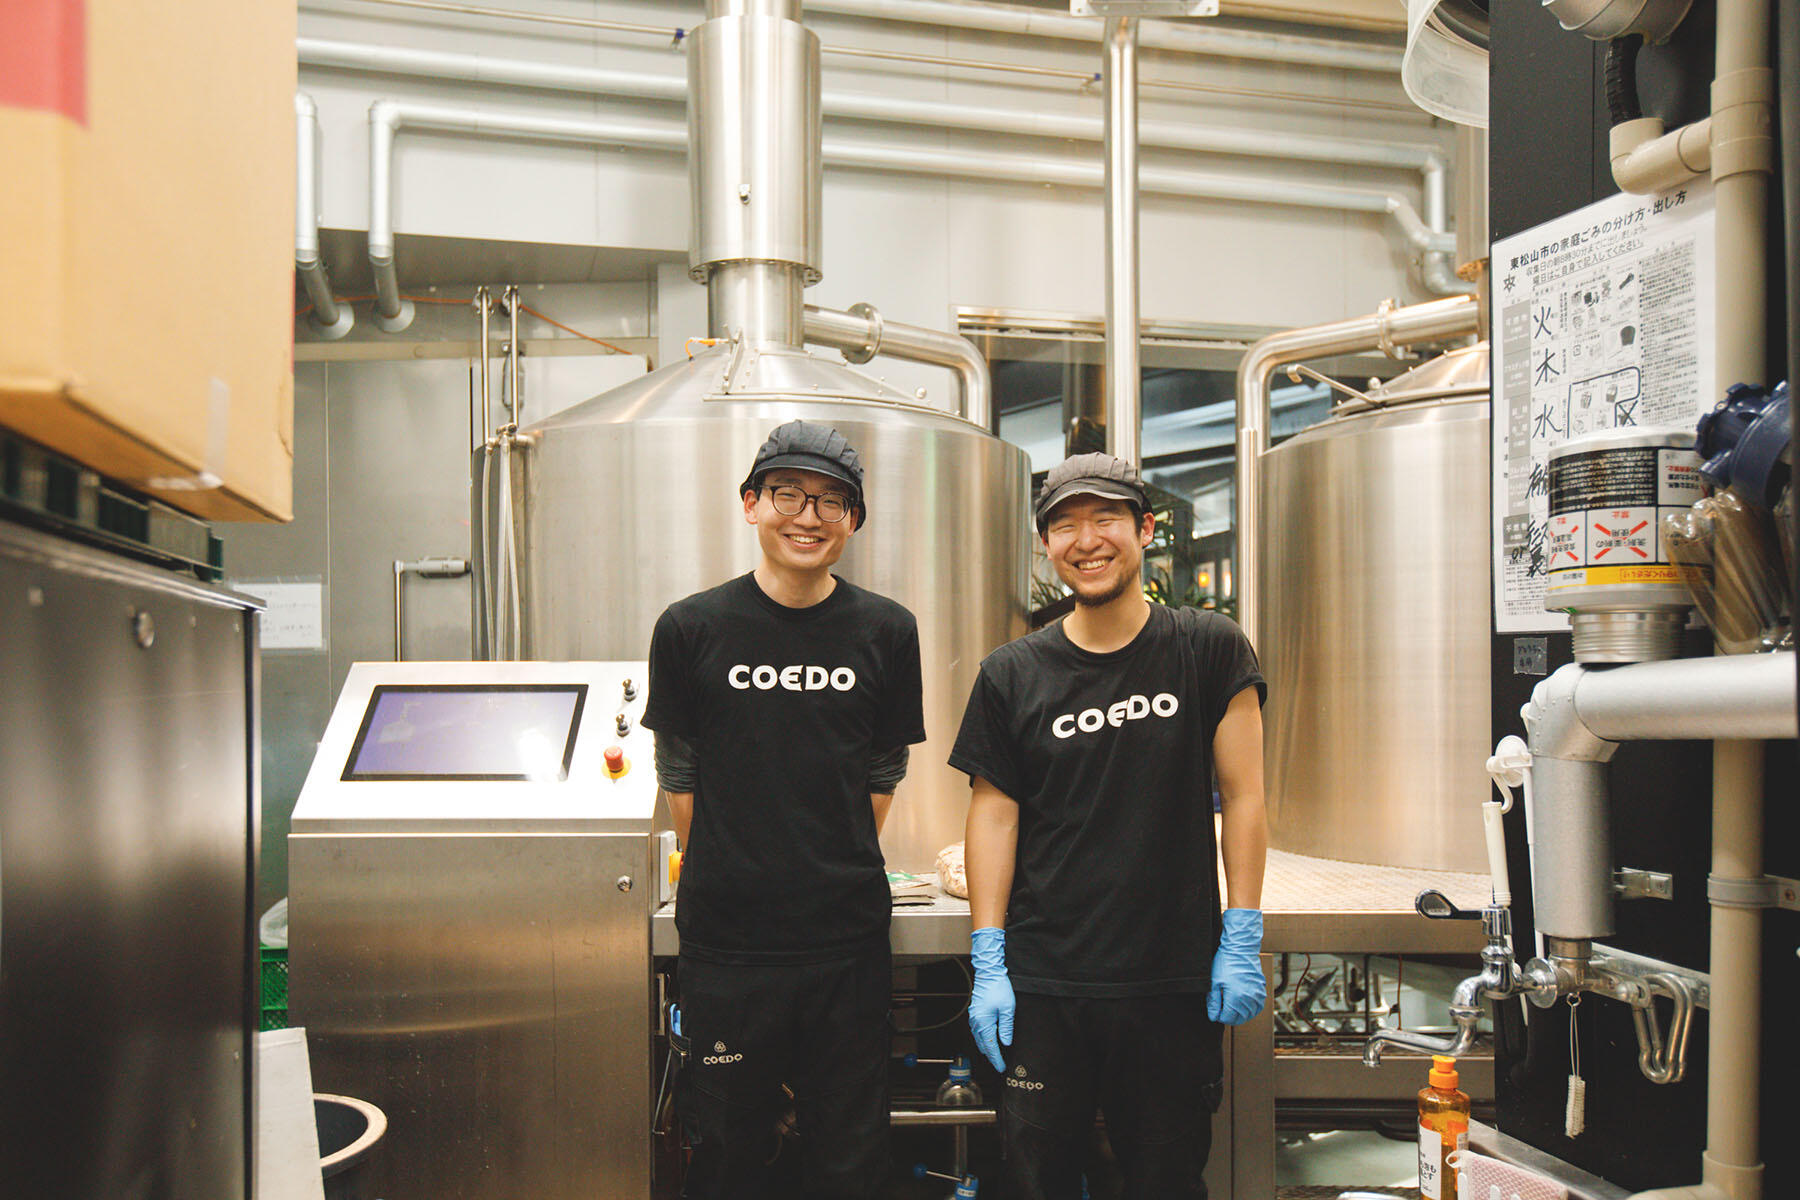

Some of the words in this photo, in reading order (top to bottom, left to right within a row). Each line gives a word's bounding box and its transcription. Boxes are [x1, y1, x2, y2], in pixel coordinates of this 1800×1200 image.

[1510, 190, 1687, 270] 東松山市の家庭ごみの分け方・出し方
[1533, 306, 1551, 339] 火
[1532, 403, 1561, 438] 水
[728, 664, 856, 692] COEDO
[1052, 693, 1179, 739] COEDO
[703, 1053, 743, 1066] COEDO
